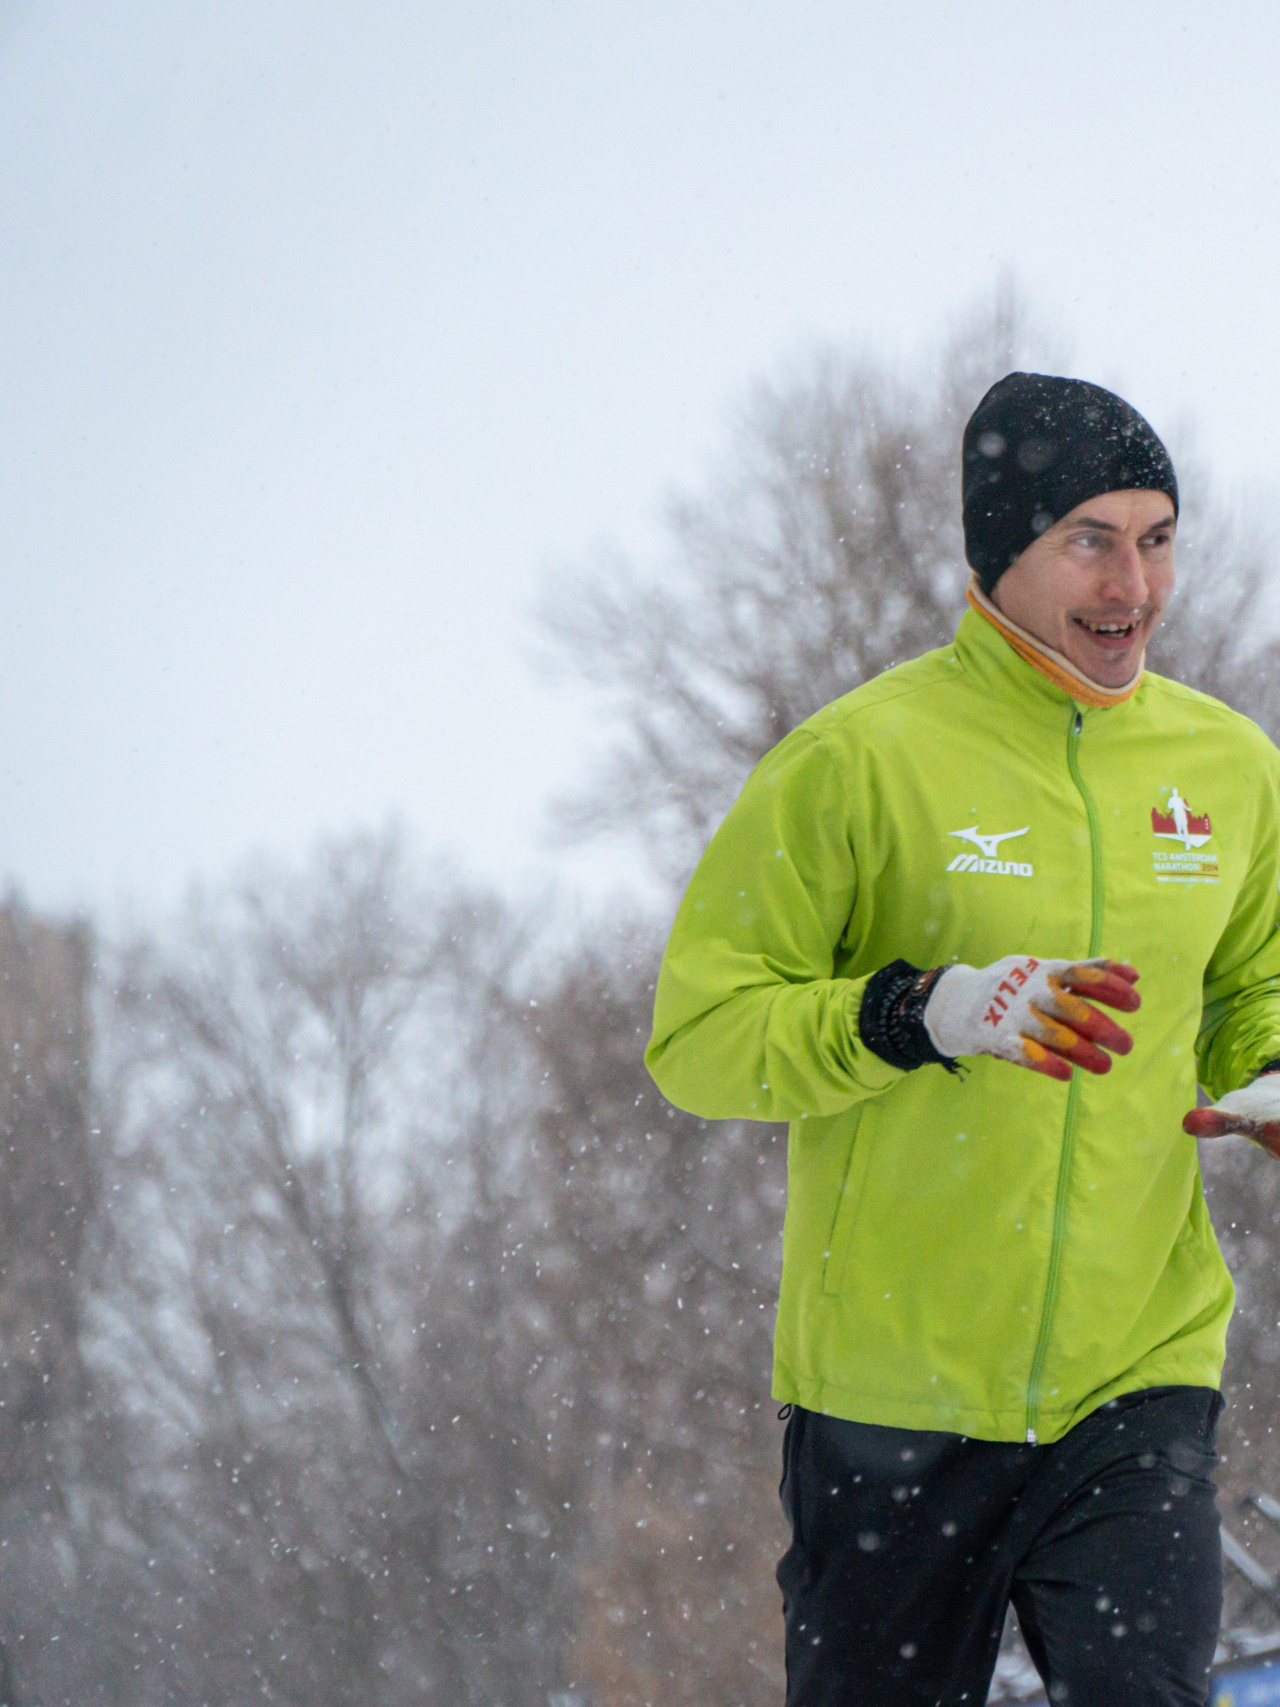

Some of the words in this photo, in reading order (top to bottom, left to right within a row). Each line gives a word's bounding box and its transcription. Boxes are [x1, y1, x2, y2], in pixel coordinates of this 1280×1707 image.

[1152, 852, 1167, 861] TCS
[1169, 853, 1217, 863] AMSTERDAM
[1153, 862, 1200, 871] MARATHON
[1202, 864, 1218, 872] 2014
[983, 957, 1040, 1029] FELIX
